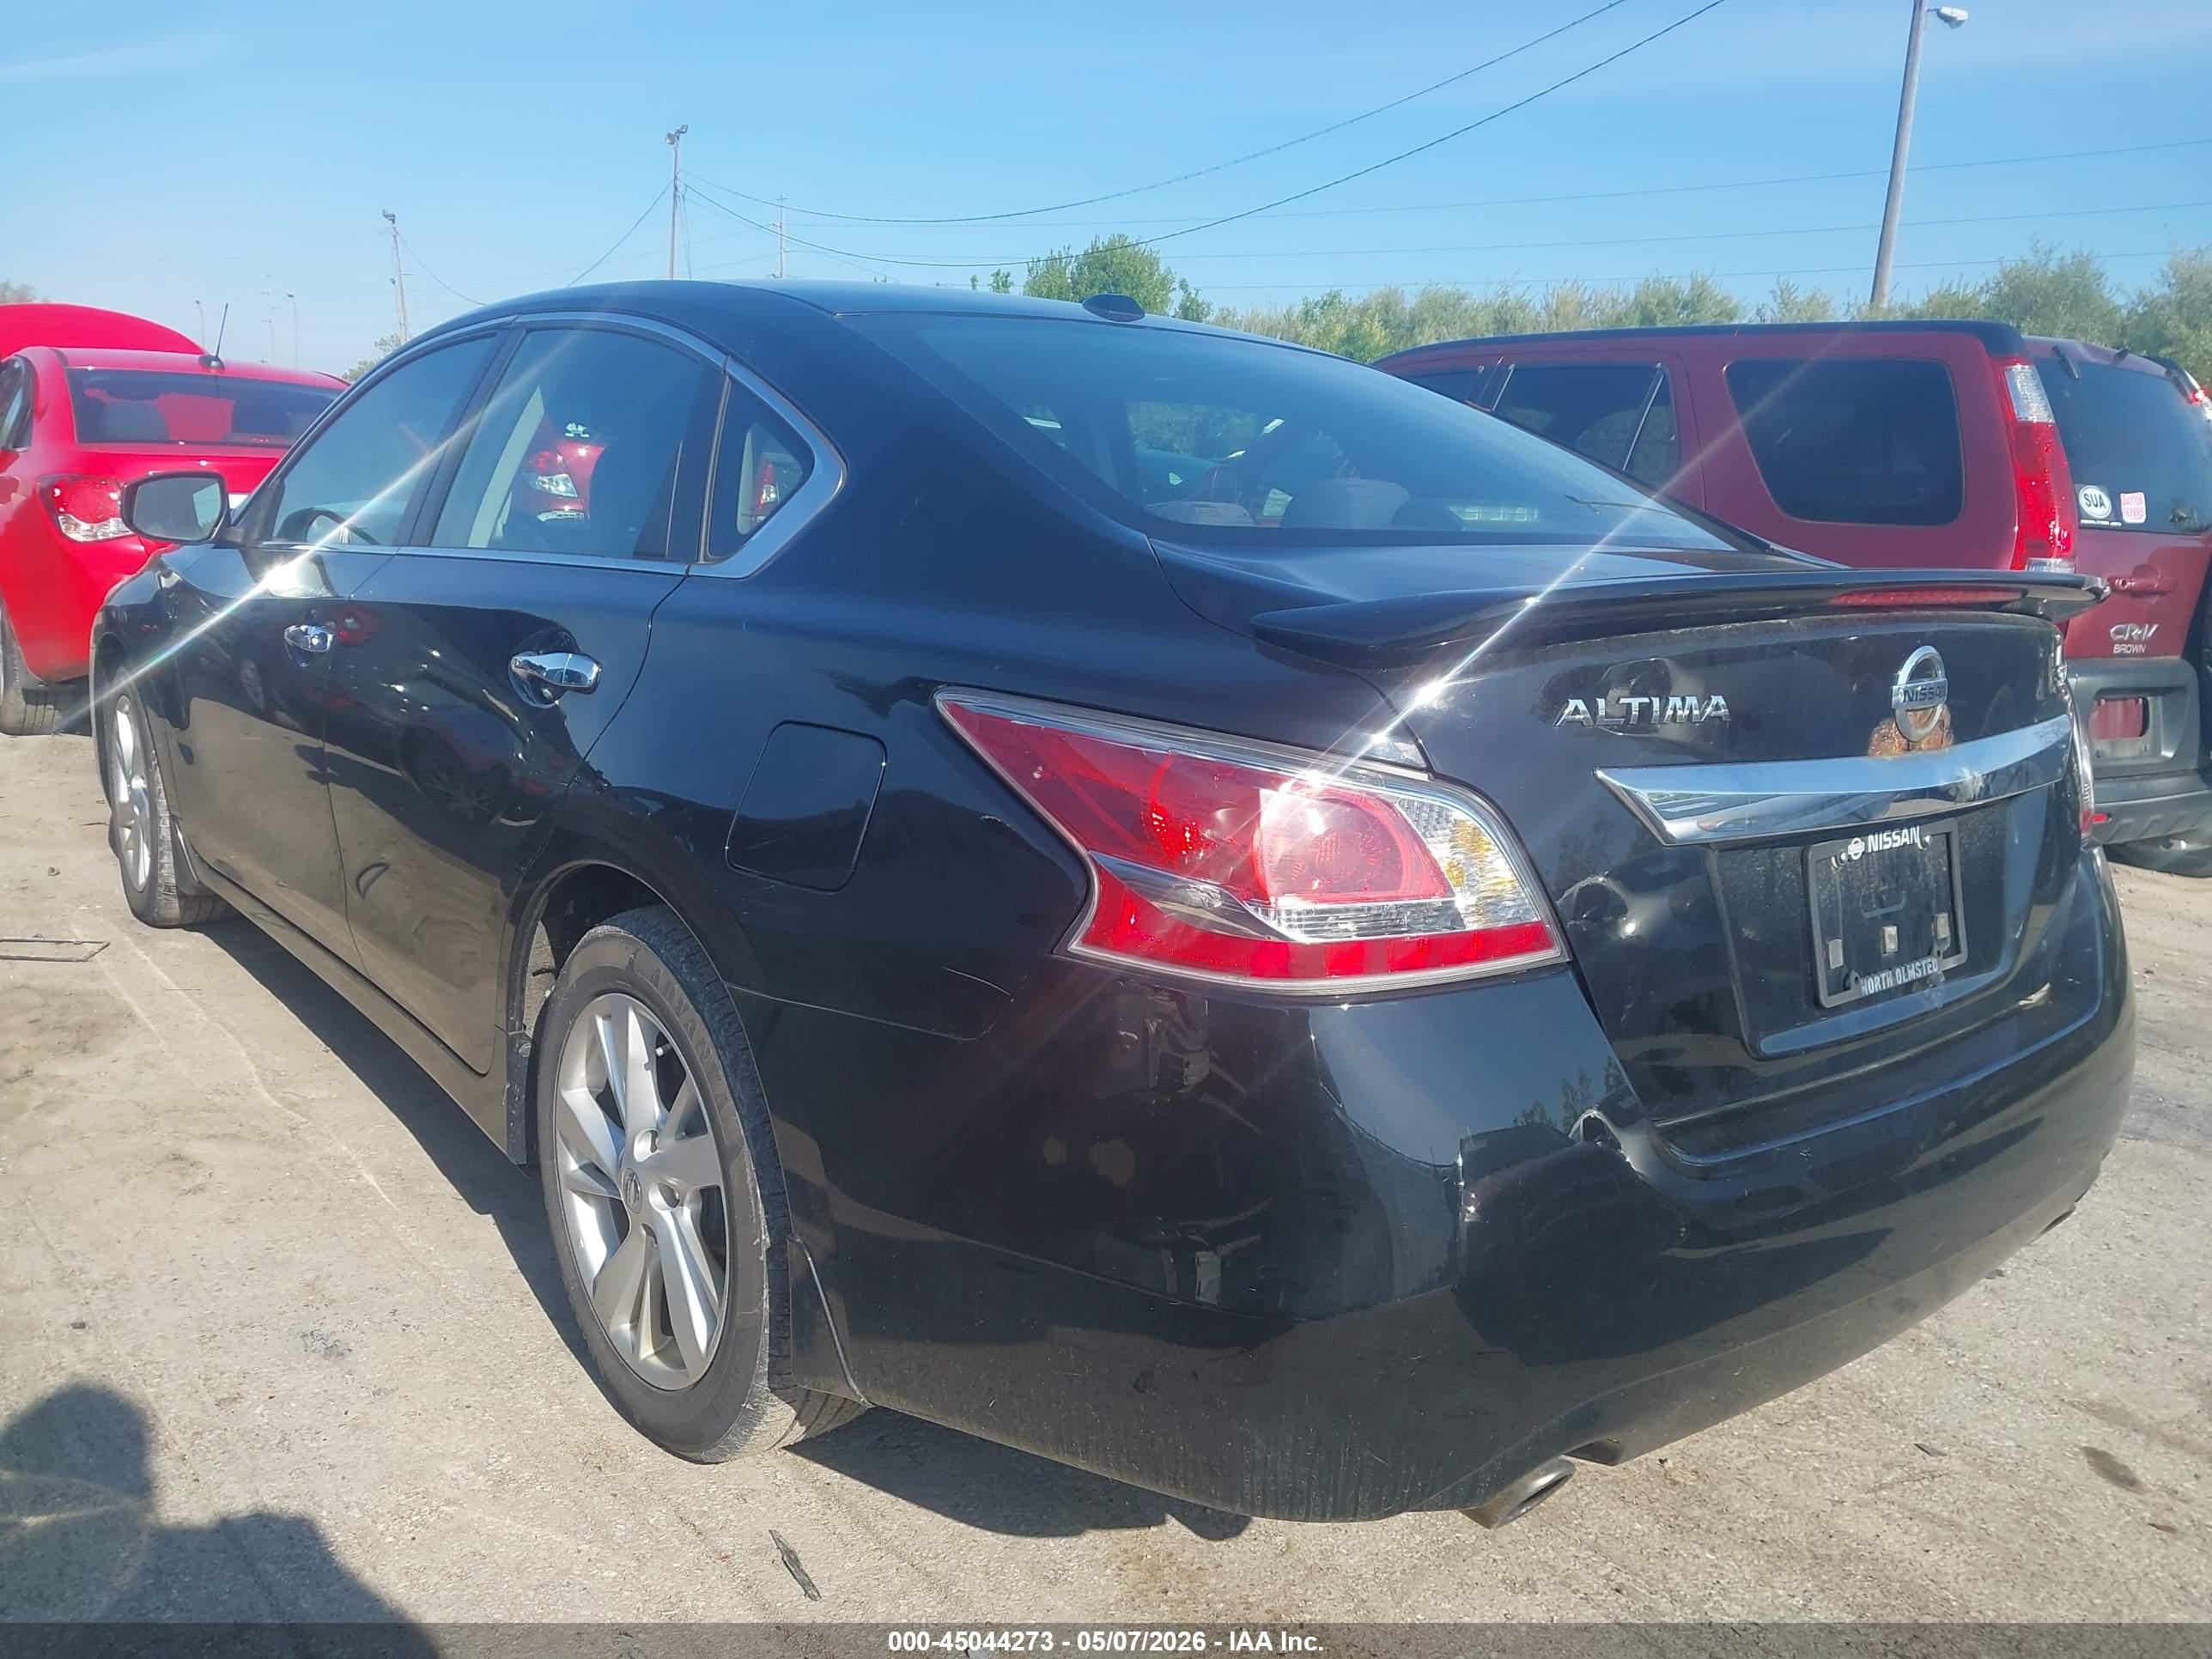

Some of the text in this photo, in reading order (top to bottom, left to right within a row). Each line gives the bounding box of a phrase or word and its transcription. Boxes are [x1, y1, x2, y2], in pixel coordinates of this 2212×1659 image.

[2083, 493, 2107, 509] SUA
[2113, 643, 2147, 653] BROWN
[1553, 694, 1732, 728] ALTIMA
[1868, 825, 1921, 854] NISSAN
[1861, 957, 1938, 996] NORTH OLMSTED
